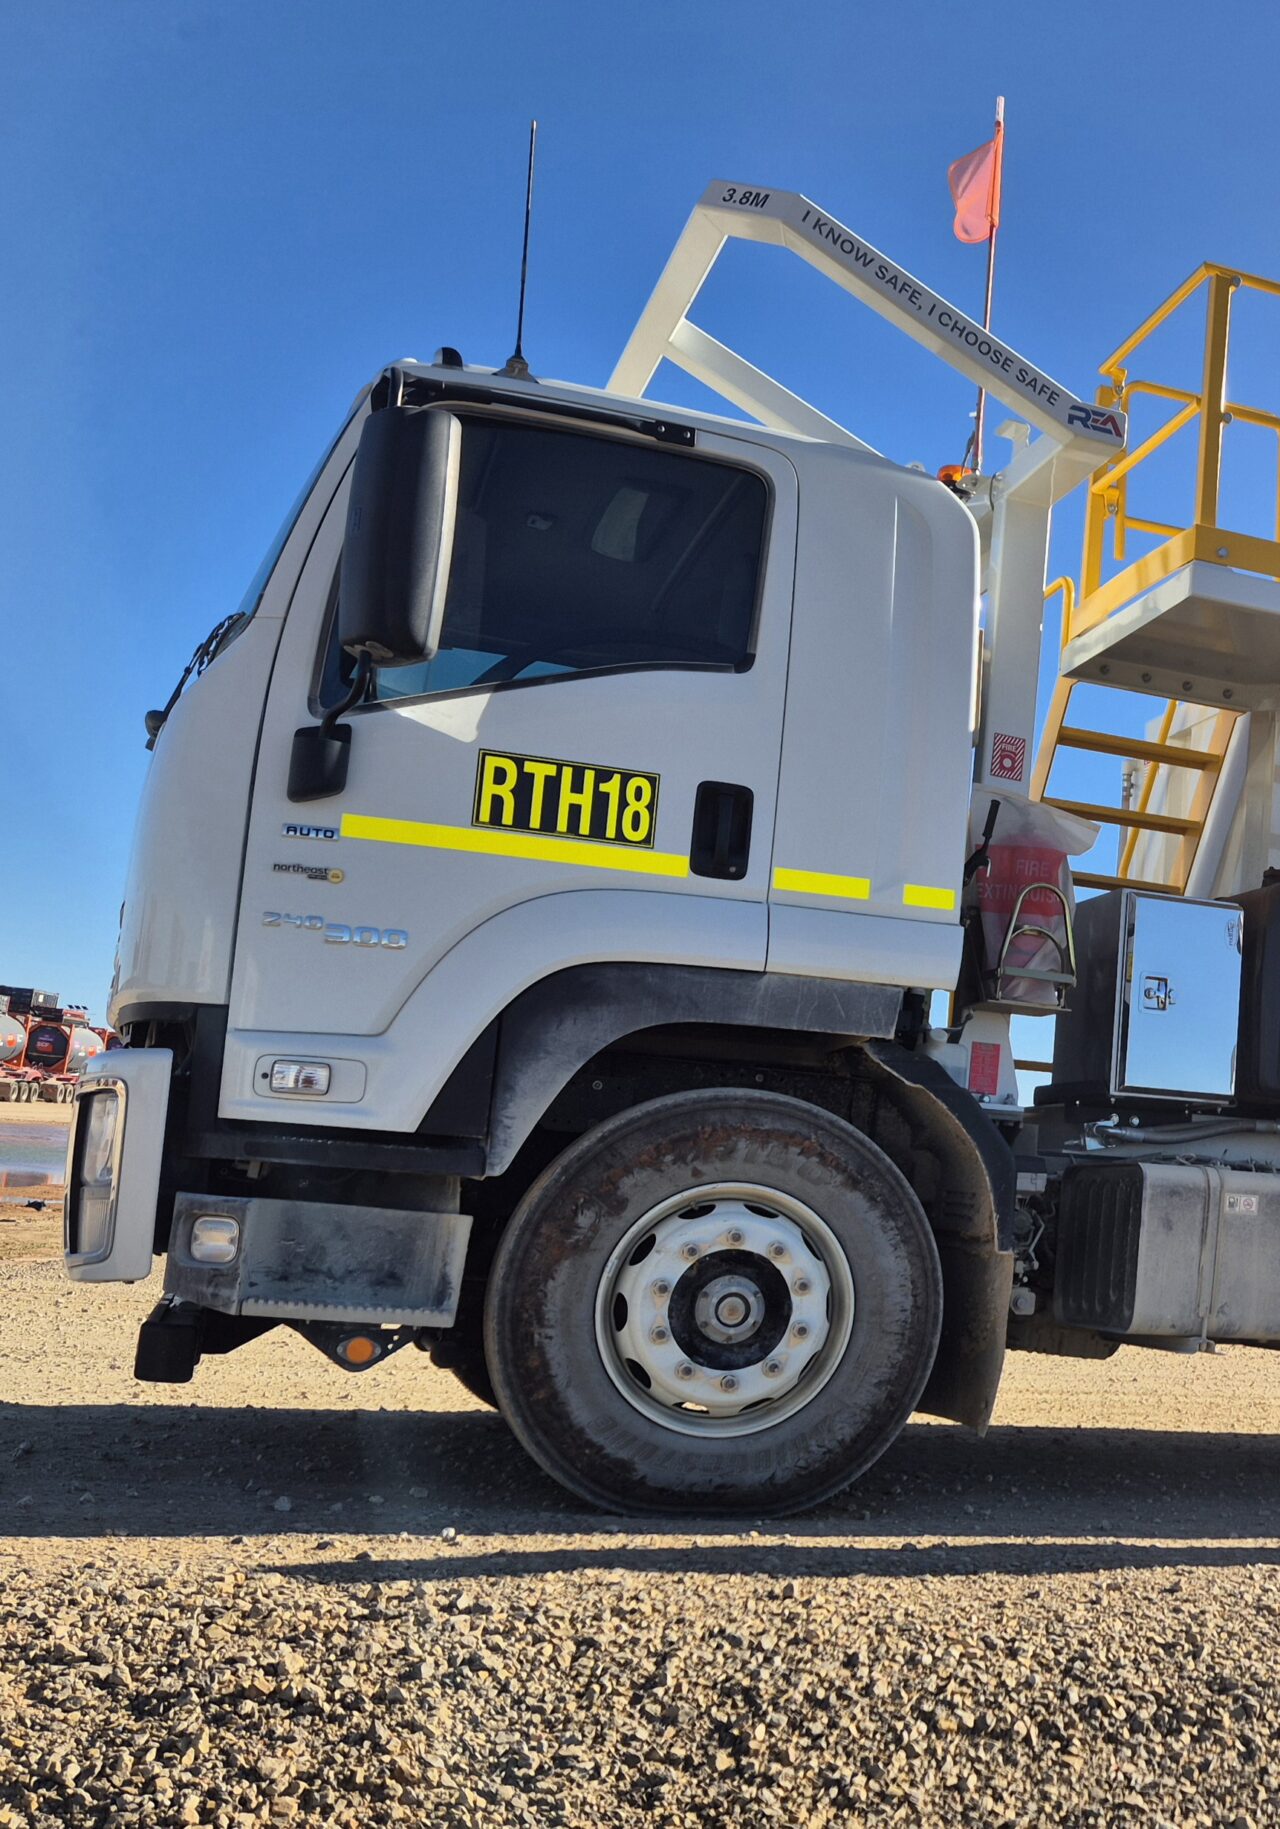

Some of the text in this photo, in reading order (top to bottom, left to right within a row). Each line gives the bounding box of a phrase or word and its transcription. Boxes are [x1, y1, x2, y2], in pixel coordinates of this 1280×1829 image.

[722, 188, 769, 208] 3.8M
[802, 210, 811, 223] I
[812, 217, 876, 268] KNOW
[928, 303, 937, 316] I
[938, 312, 1015, 373] CHOOSE
[1016, 368, 1060, 406] SAFE
[478, 755, 652, 842] RTH18
[286, 826, 335, 838] AUTO
[273, 863, 329, 875] northeast
[1015, 859, 1050, 877] FIRE
[262, 911, 408, 950] 240 300
